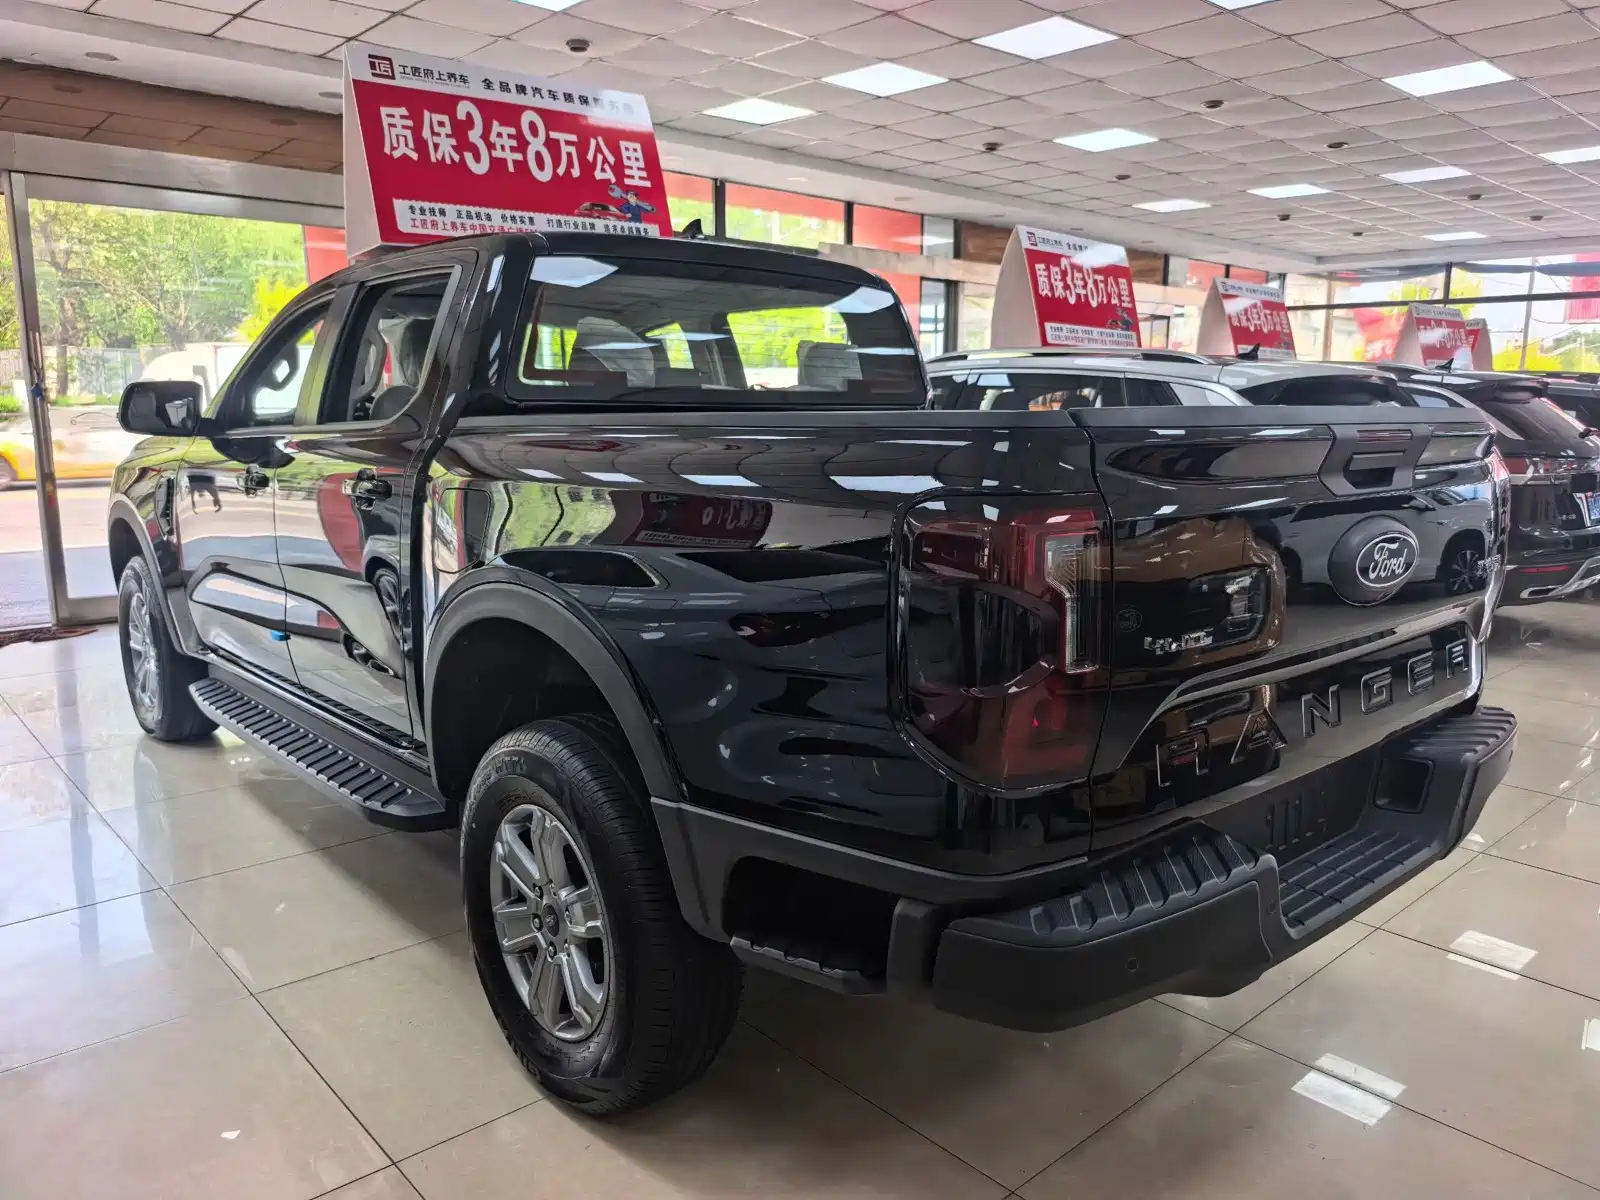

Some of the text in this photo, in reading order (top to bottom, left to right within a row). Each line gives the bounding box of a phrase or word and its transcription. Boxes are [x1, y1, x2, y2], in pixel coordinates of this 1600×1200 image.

[398, 64, 470, 85] 工匠府上养车
[481, 78, 635, 116] 全品牌汽车质保
[380, 100, 652, 188] 质保3年8万公里
[408, 205, 447, 218] 专业技师
[456, 209, 493, 222] 正品机油
[501, 213, 536, 226] 价格实惠
[1034, 257, 1133, 308] 质保3年8万公里
[1369, 542, 1407, 580] Ford
[1155, 637, 1470, 788] RANGER
